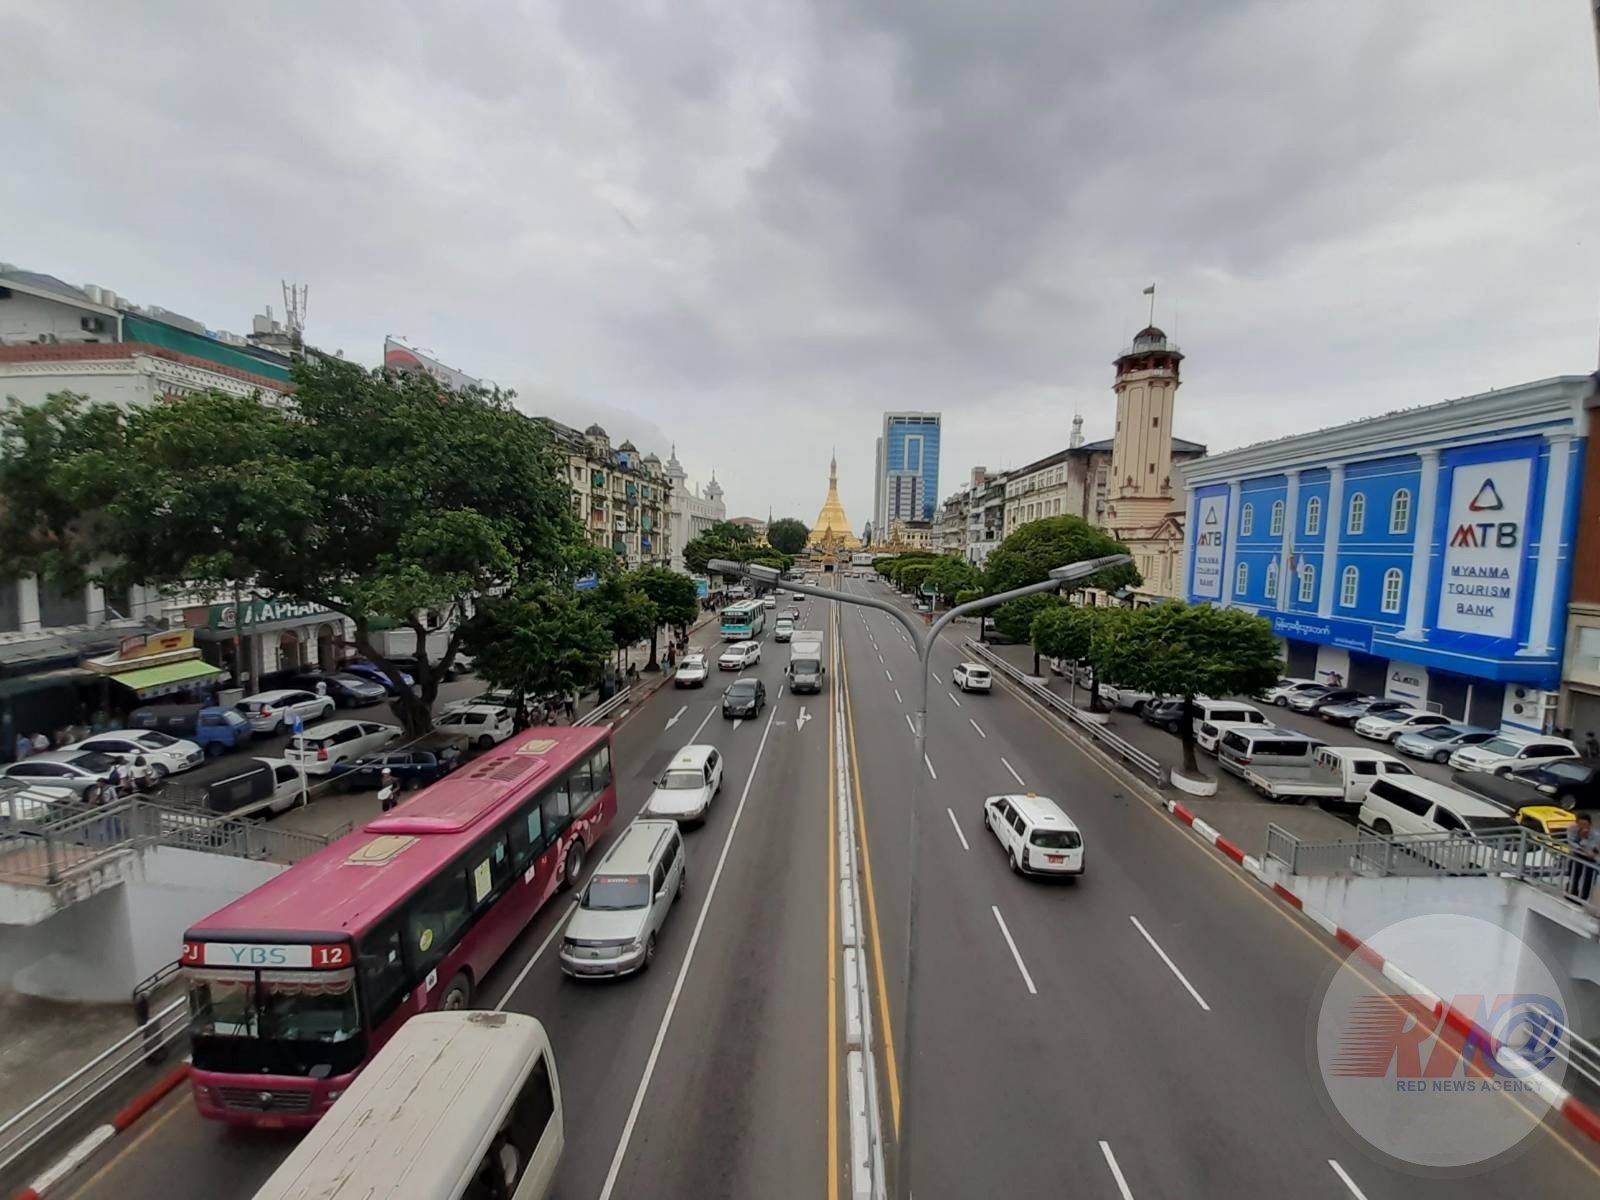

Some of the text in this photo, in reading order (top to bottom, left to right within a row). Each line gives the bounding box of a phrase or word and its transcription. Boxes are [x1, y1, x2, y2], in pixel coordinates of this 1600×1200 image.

[1198, 531, 1222, 546] MTB
[1451, 522, 1518, 549] MTB
[1451, 565, 1510, 579] MYANMA
[1447, 583, 1511, 599] TOURISM
[1456, 602, 1495, 617] BANK
[230, 946, 287, 964] YBS
[320, 948, 342, 964] 12
